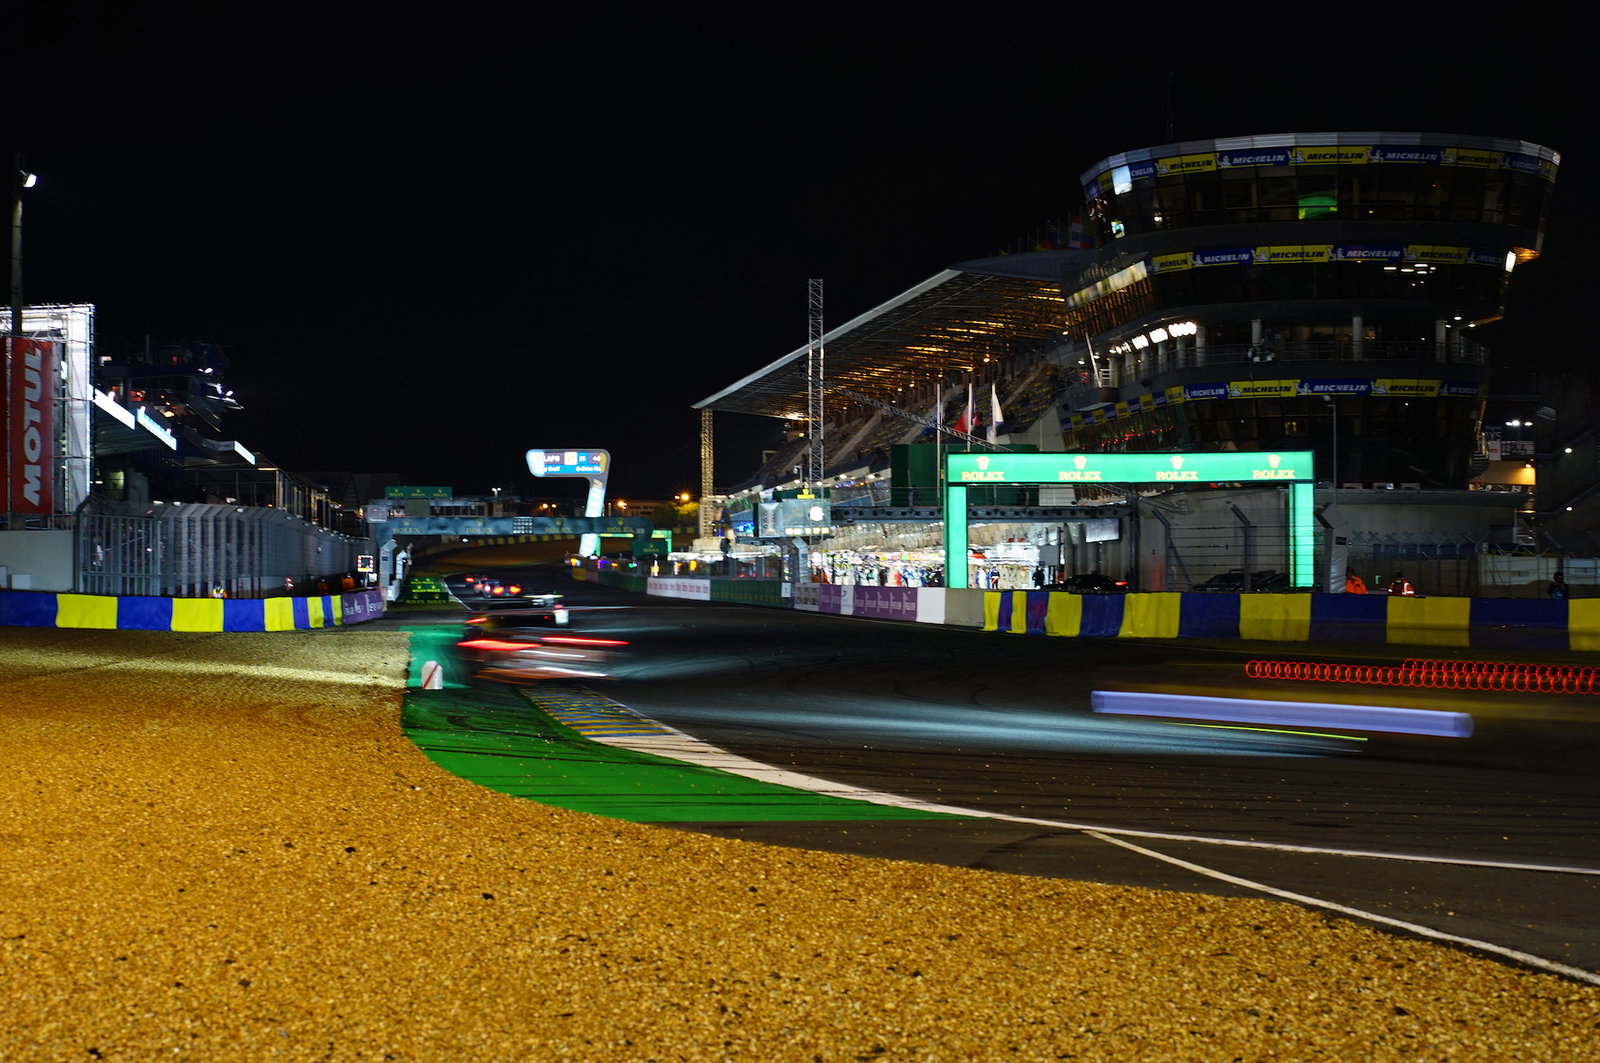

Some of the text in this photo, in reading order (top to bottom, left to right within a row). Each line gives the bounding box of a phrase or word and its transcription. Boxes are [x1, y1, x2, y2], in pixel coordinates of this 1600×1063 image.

[1233, 154, 1286, 164] MICHELIN
[1307, 152, 1364, 160] MICHELIN
[1386, 151, 1438, 161] MICHELIN
[1169, 159, 1213, 170] MICHELIN
[1203, 253, 1249, 263] MICHELIN
[1270, 251, 1324, 259] MICHELIN
[1346, 250, 1401, 258] MICHELIN
[1190, 387, 1225, 398] MICHELIN
[1242, 385, 1292, 393] MICHELIN
[1314, 384, 1368, 392] MICHELIN
[1389, 384, 1435, 392] MICHELIN
[23, 346, 42, 507] MOTUL
[961, 470, 1296, 480] ROLEX ROLEX ROLEX ROLEX
